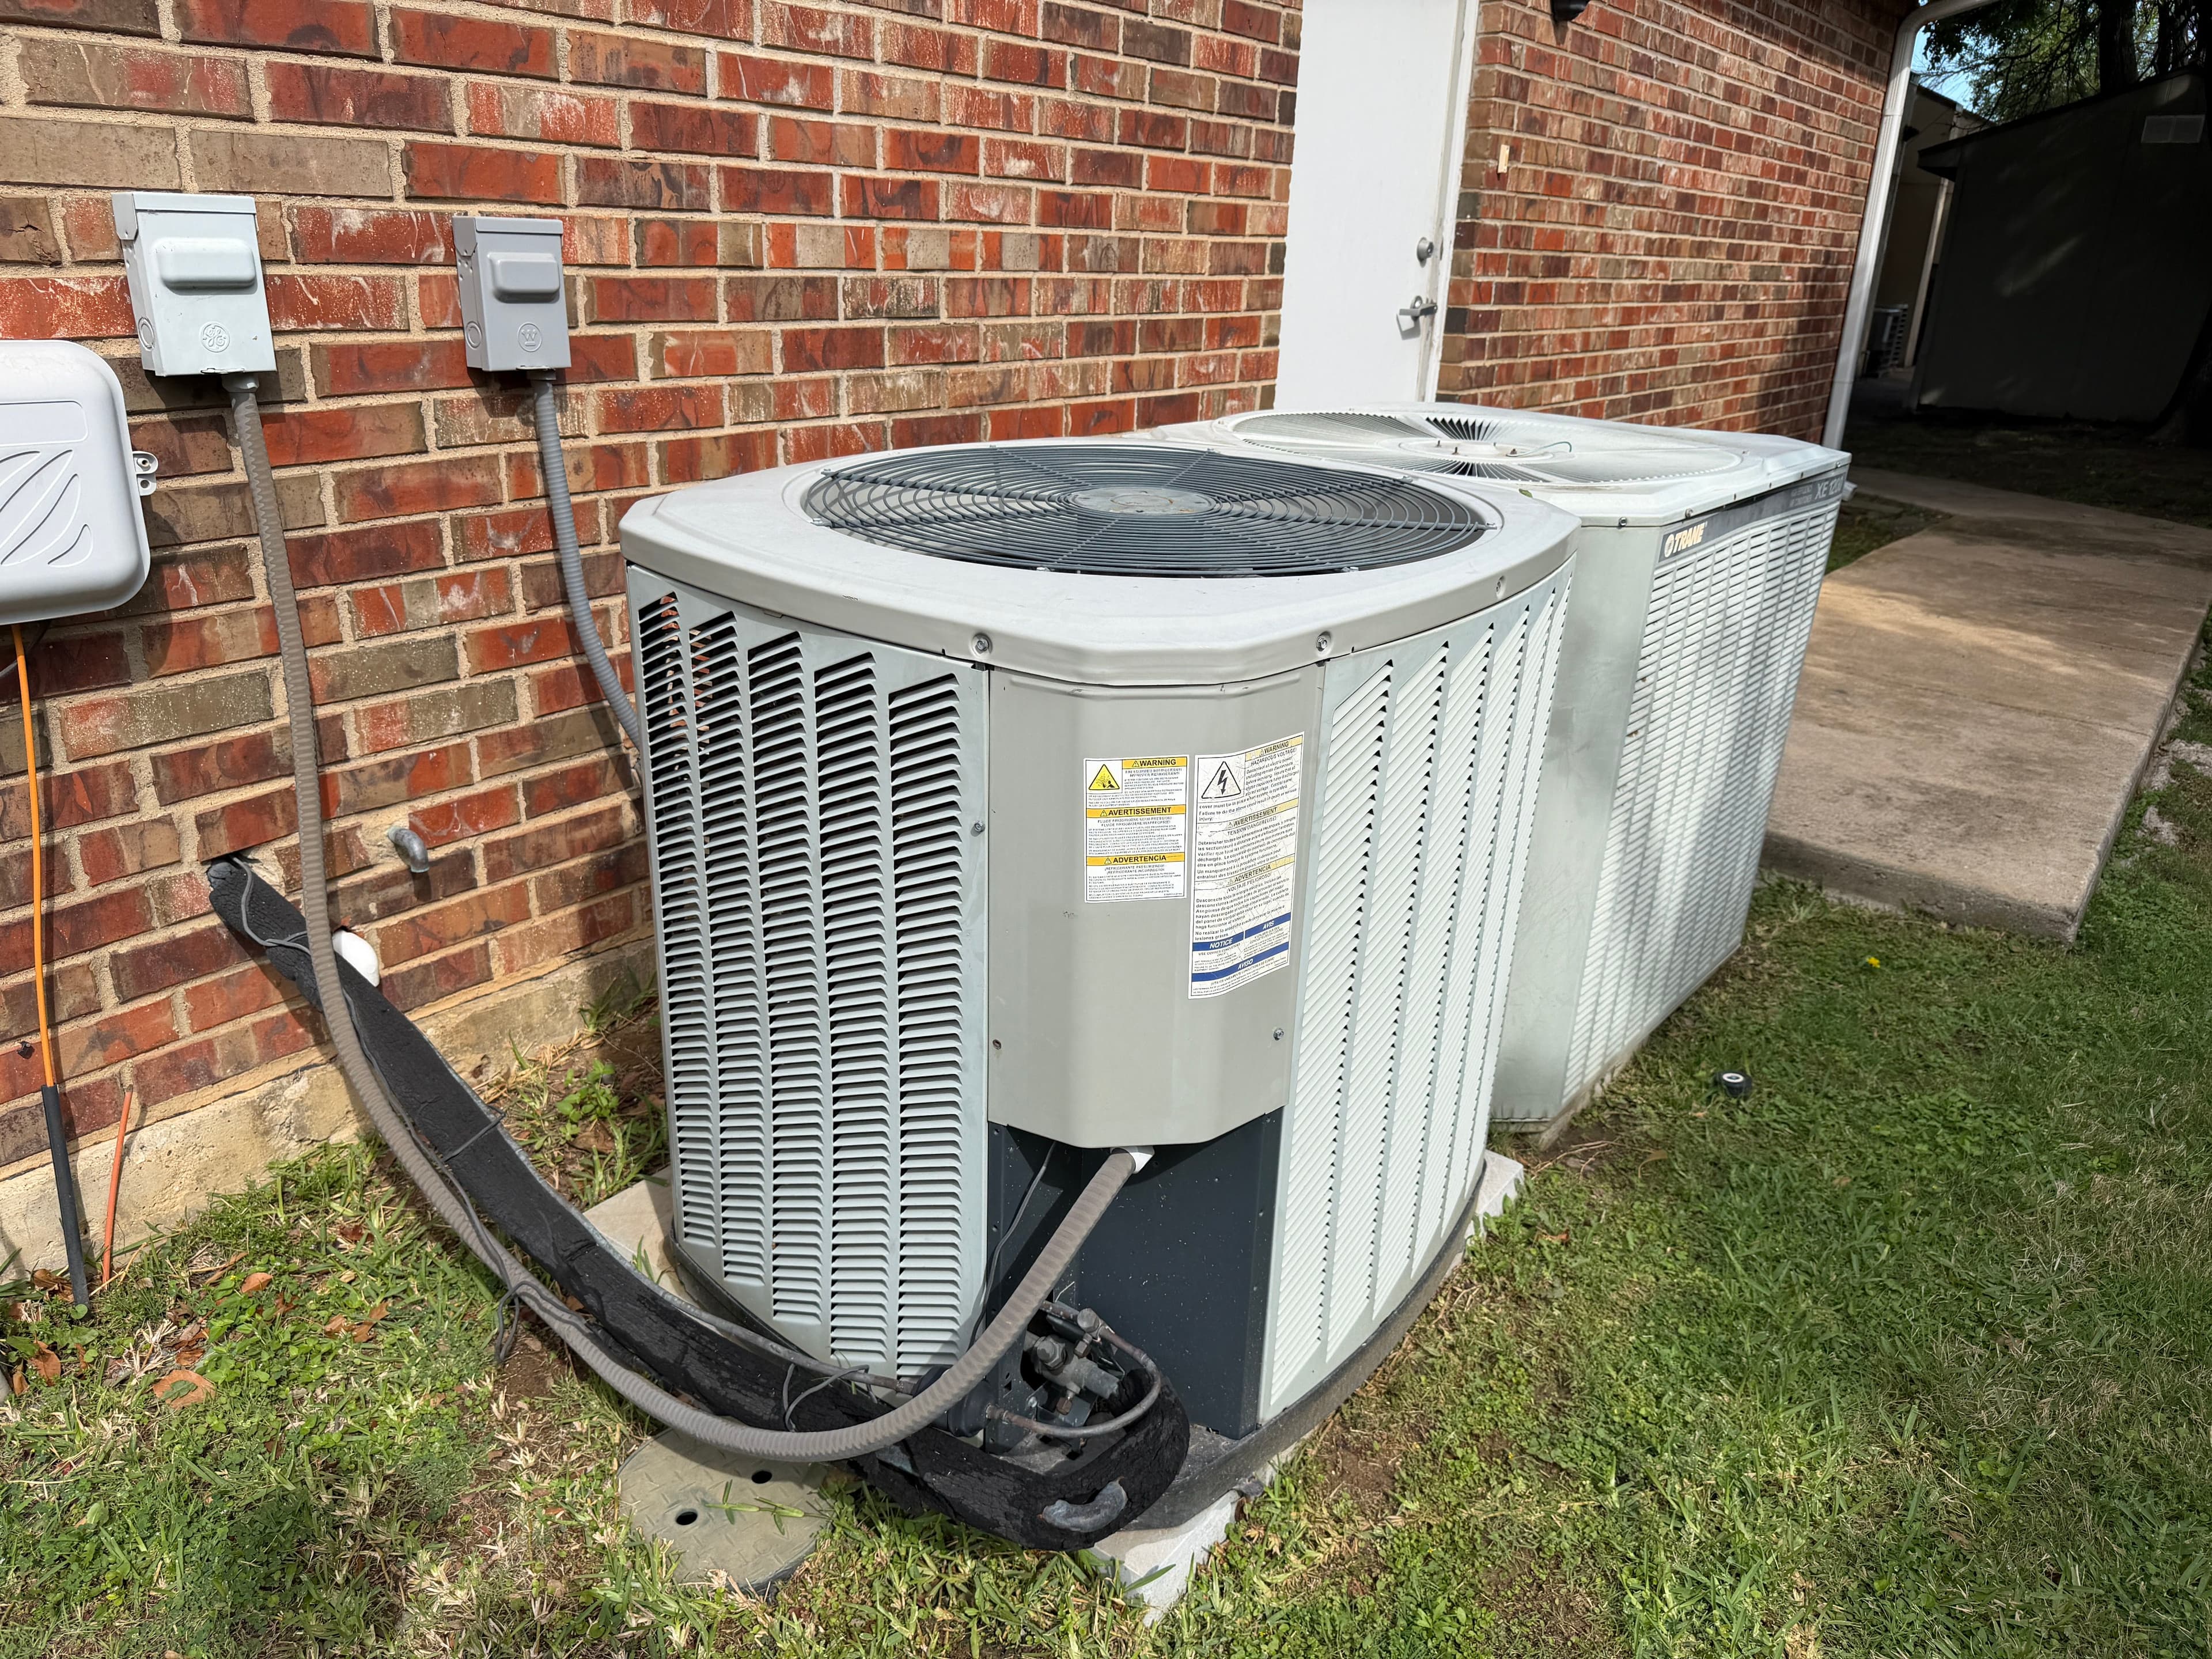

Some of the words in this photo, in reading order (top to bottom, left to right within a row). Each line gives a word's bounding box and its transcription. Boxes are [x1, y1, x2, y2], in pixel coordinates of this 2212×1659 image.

[1815, 480, 1830, 500] XE
[1673, 522, 1705, 554] TRANE
[1264, 741, 1289, 754] WARNING
[1139, 759, 1176, 767] WARNING
[1108, 807, 1171, 816] AVERTISSEMENT
[1234, 807, 1277, 827] AVERTISSEMENT
[1113, 855, 1166, 863] ADVERTENCIA
[1234, 865, 1271, 882] ADVERTENCIA
[1263, 921, 1274, 930] AVIS
[1210, 938, 1233, 949] NOTICE
[1237, 959, 1253, 970] AVISO
